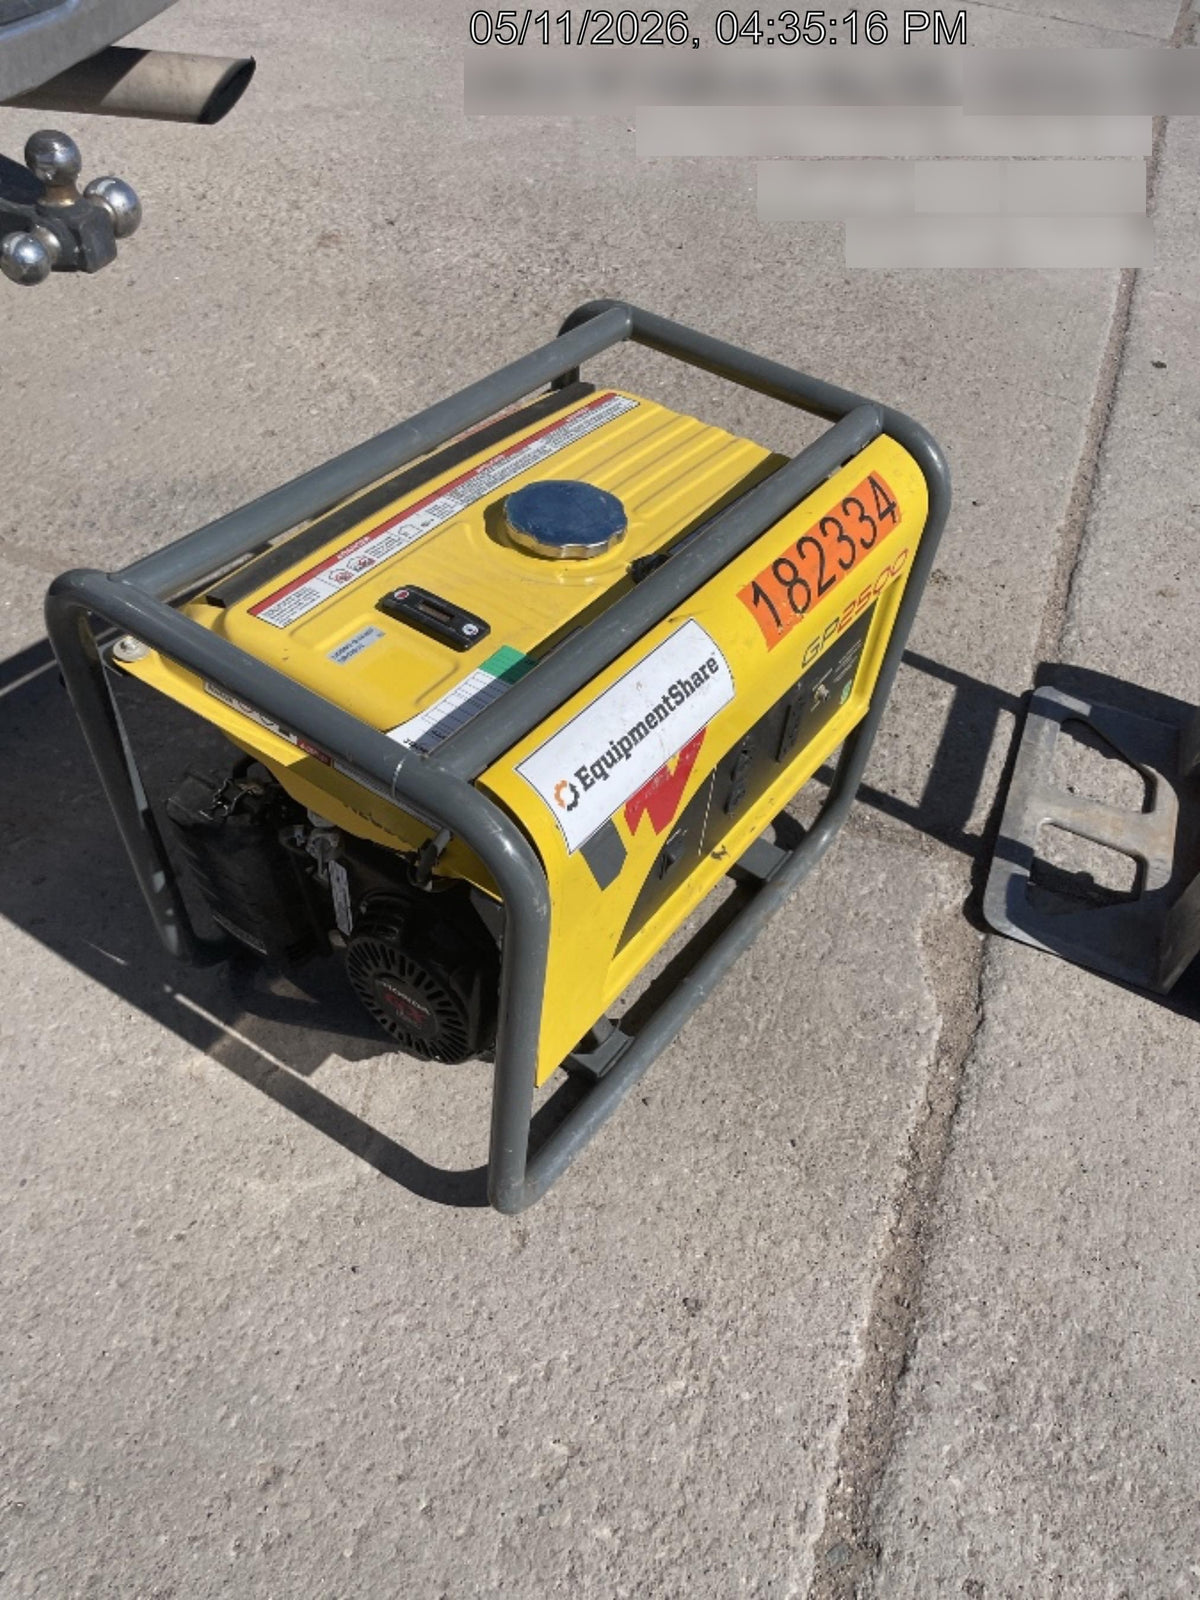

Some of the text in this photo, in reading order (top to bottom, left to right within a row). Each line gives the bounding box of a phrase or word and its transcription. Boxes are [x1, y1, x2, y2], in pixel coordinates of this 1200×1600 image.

[751, 475, 898, 634] 182334
[801, 548, 909, 668] GP2500
[573, 656, 720, 792] EquipmentShare
